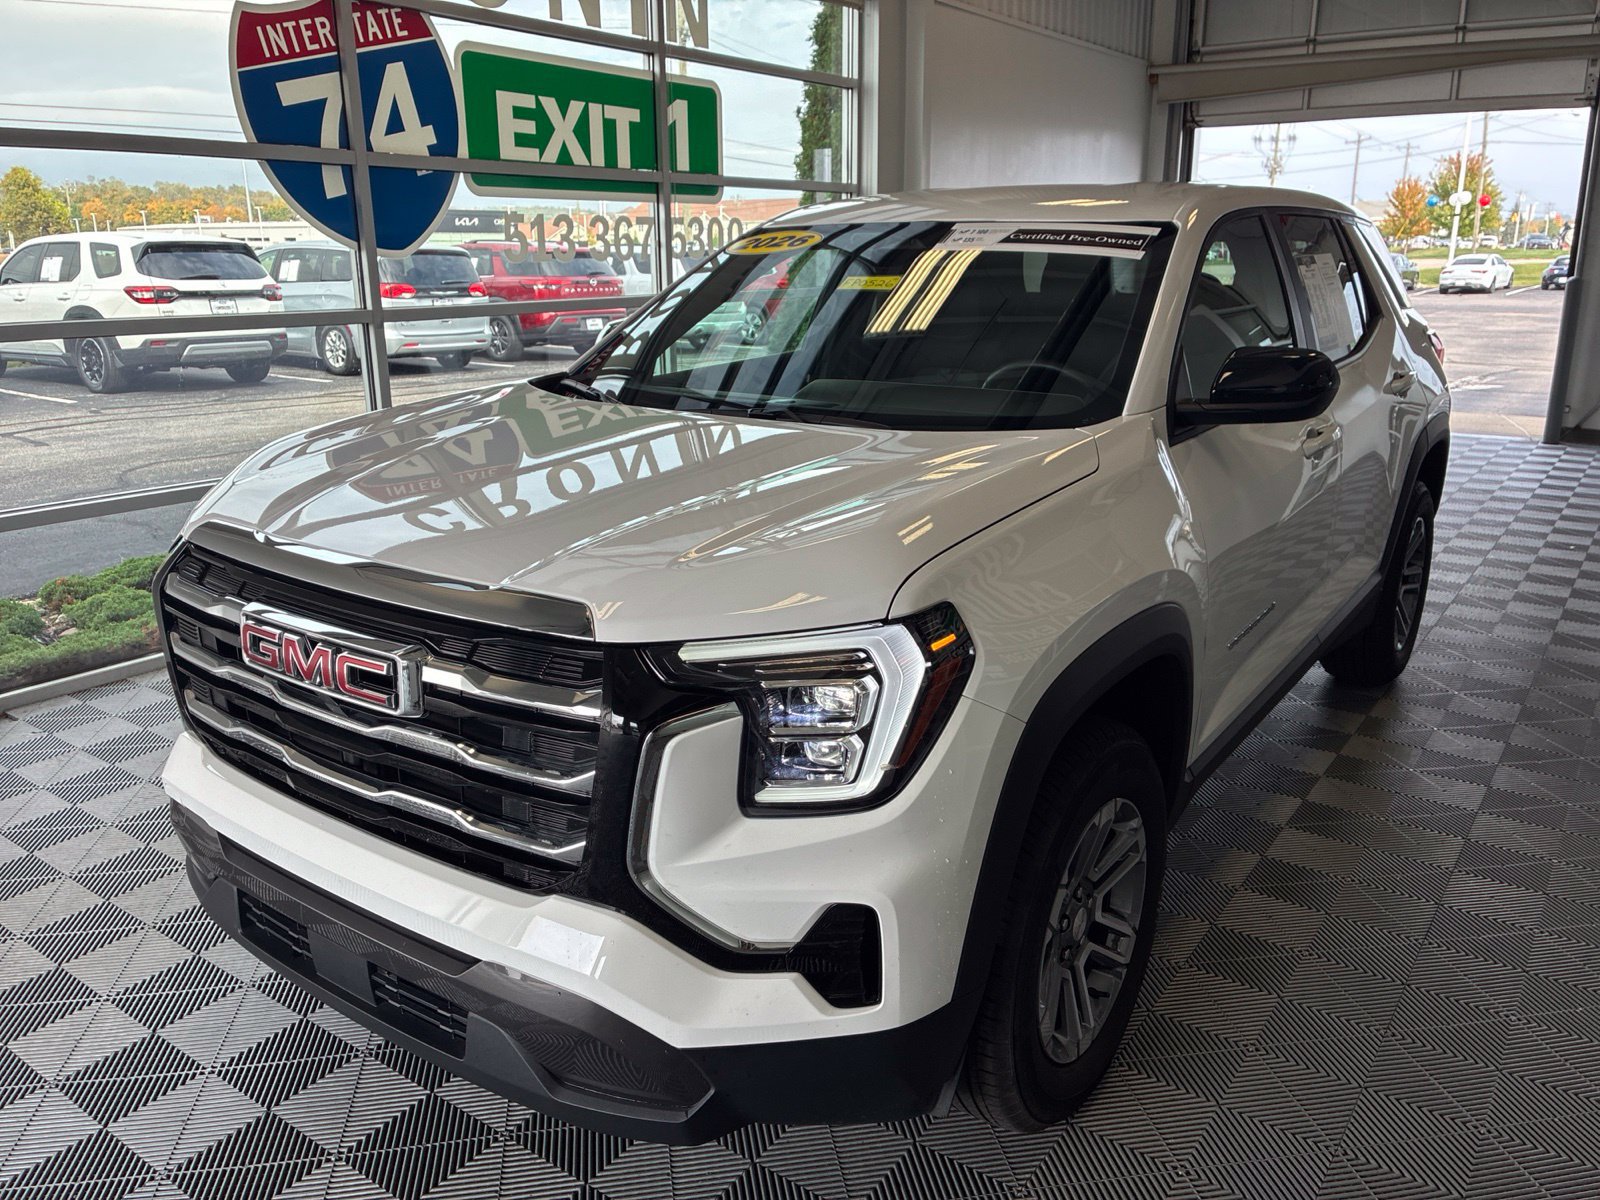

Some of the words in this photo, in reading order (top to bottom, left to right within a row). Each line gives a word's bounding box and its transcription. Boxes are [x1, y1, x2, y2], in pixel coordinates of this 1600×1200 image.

[256, 8, 409, 58] INTERTATE
[276, 61, 437, 199] 74
[495, 90, 641, 169] EXIT
[667, 99, 690, 172] 1
[742, 234, 815, 250] 2026
[1009, 231, 1068, 242] Certified
[1068, 233, 1144, 247] Pre-Owned
[242, 620, 394, 706] GMC
